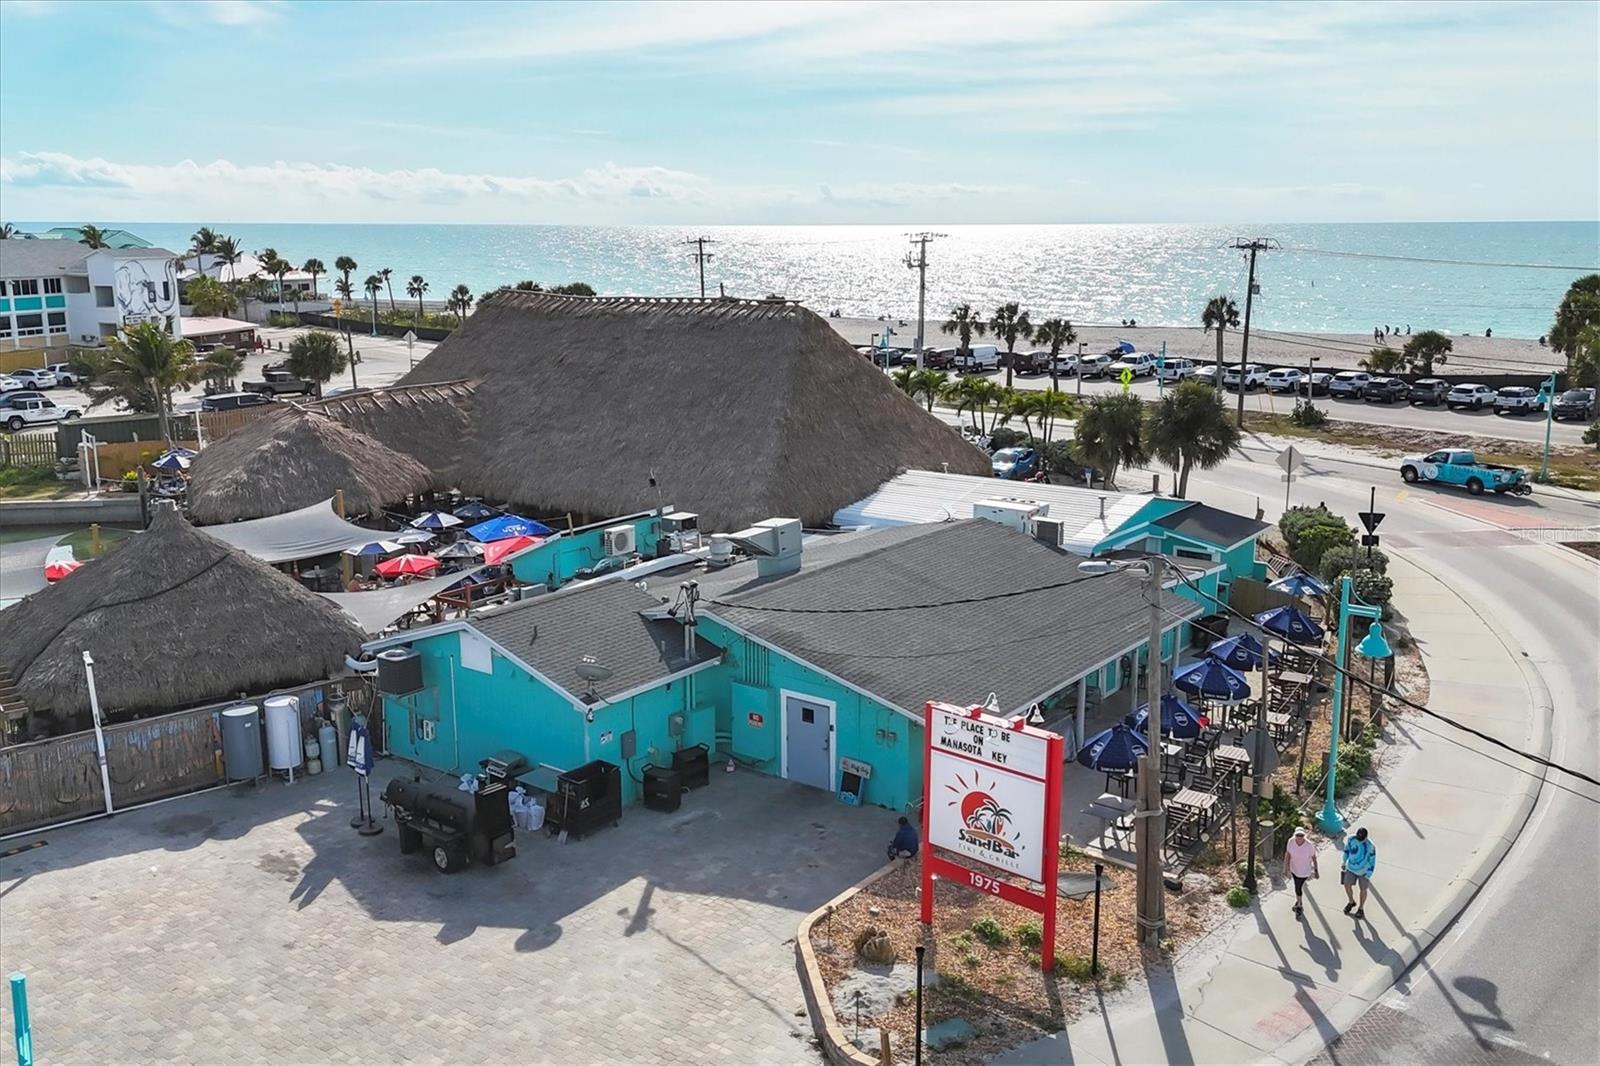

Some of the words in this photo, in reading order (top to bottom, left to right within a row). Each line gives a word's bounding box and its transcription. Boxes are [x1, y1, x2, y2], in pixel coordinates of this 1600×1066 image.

[961, 721, 984, 735] PLACE
[1001, 732, 1011, 742] BE
[973, 735, 984, 745] ON
[940, 736, 982, 756] MANASOTA
[992, 751, 1007, 763] KEY
[958, 843, 976, 854] TIKI
[979, 850, 986, 858] &
[969, 872, 1001, 894] 1975
